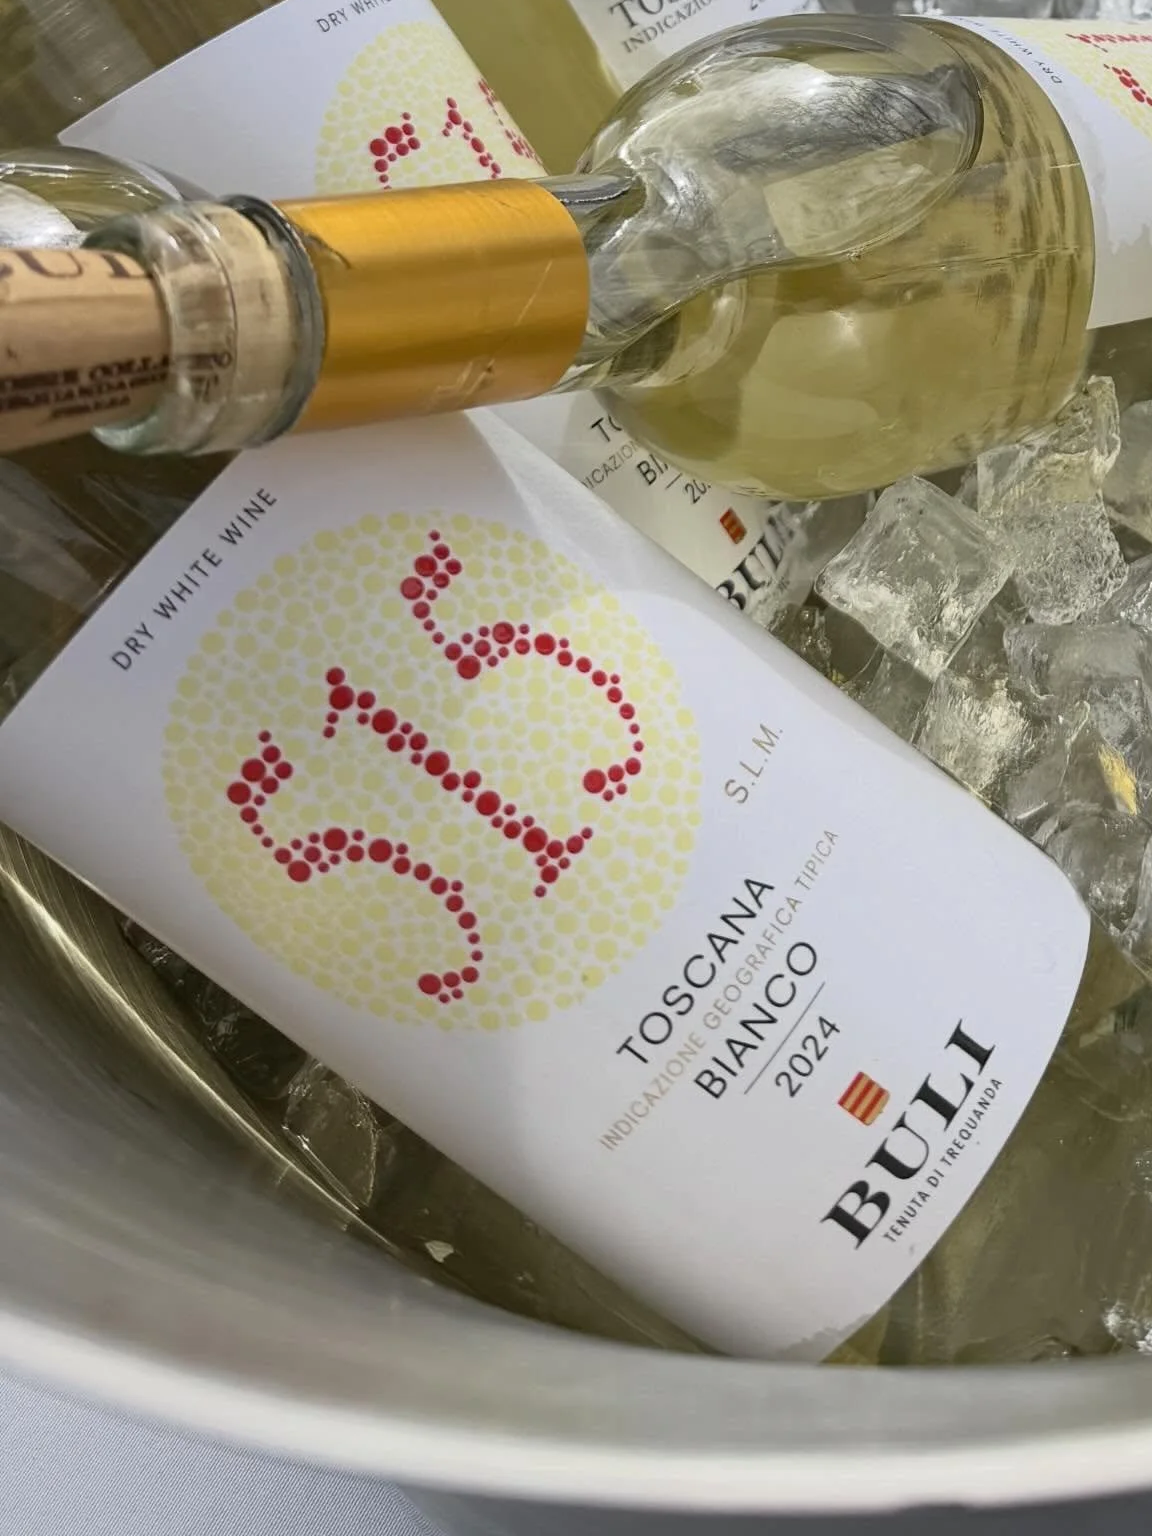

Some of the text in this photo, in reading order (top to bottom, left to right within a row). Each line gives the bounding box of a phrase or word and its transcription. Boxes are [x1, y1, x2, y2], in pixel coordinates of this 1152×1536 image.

[316, 7, 349, 33] DRY
[111, 488, 278, 671] DRY WHITE WINE
[226, 530, 645, 1004] 515
[724, 722, 784, 805] S.L.M.
[599, 829, 839, 1151] INDICAZIONE GEOGRAFICA TIPICA
[616, 877, 775, 1064] TOSCANA
[693, 942, 817, 1100] BIANCO
[775, 1015, 841, 1098] 2024
[819, 1018, 996, 1251] BULI
[883, 1077, 1002, 1243] TENUTA DI TREQUANDA
